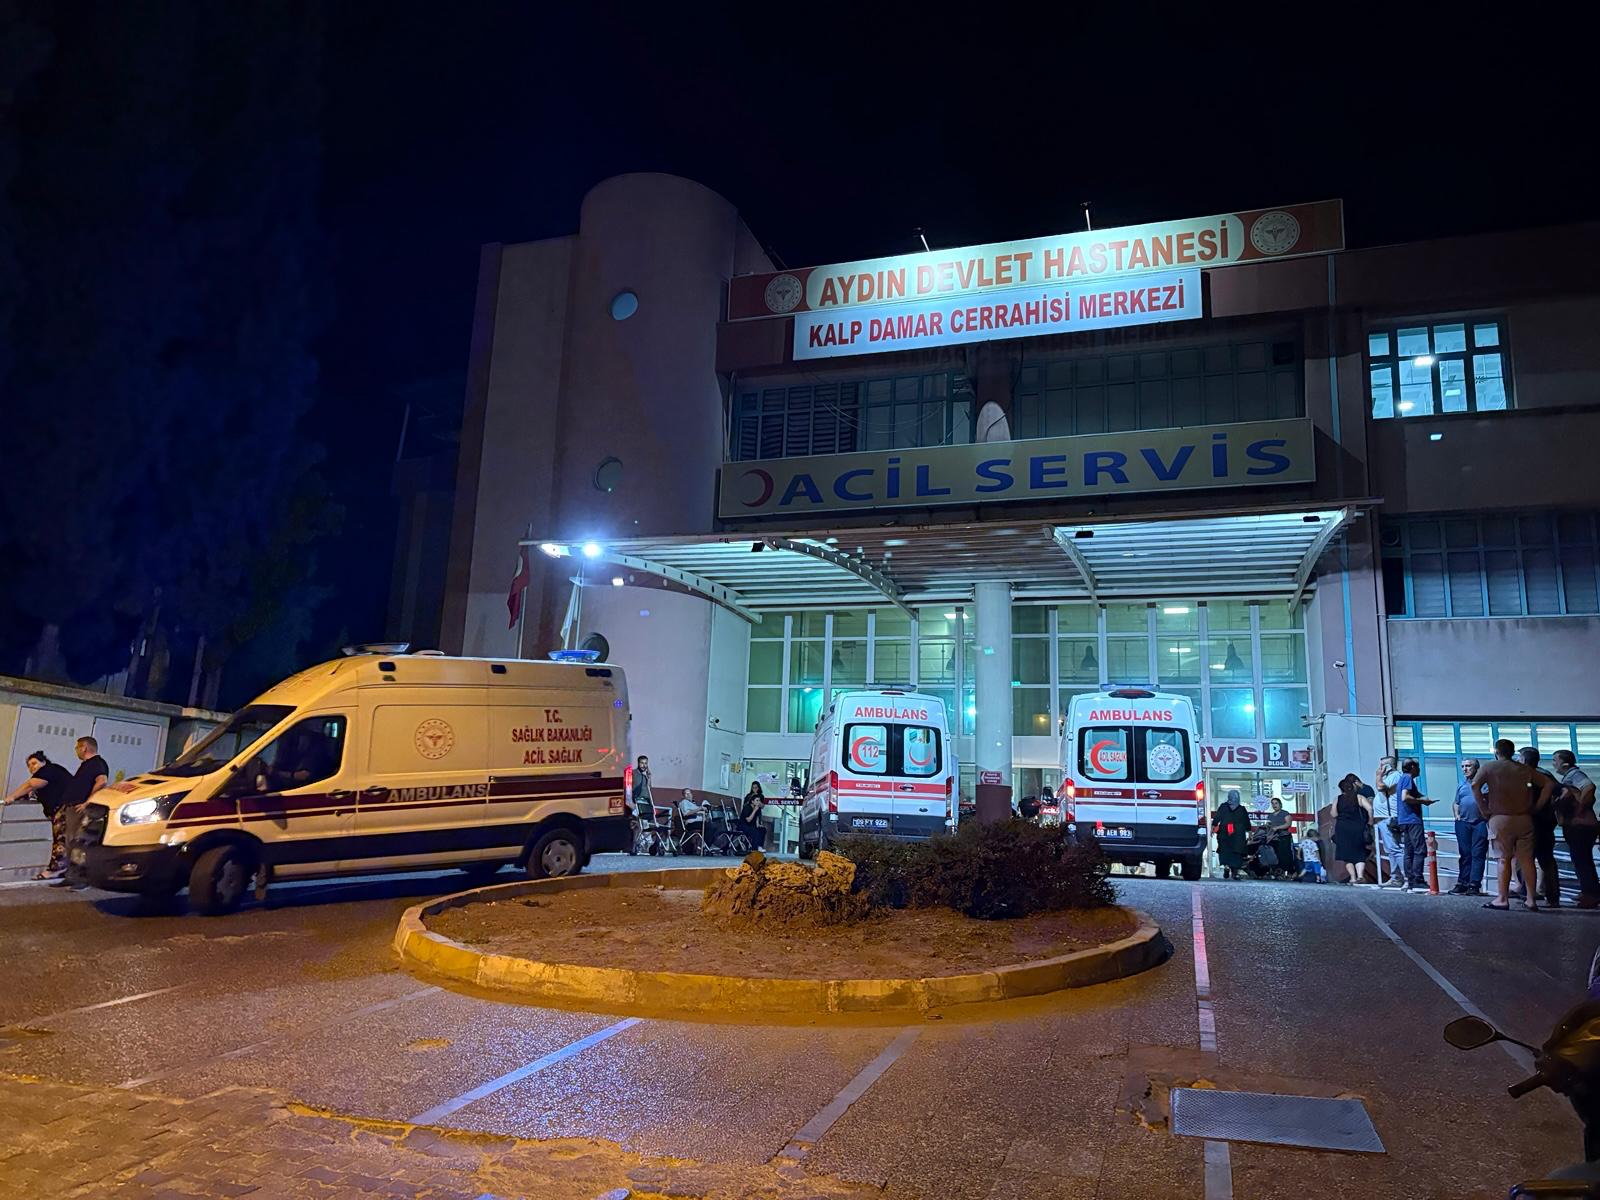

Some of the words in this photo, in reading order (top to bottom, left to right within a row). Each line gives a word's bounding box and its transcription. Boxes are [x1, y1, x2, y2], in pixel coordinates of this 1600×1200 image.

[819, 268, 906, 307] AYDIN
[917, 252, 1033, 295] DEVLET
[1044, 219, 1229, 279] HASTANESİ
[809, 320, 863, 348] KALP
[869, 312, 943, 342] DAMAR
[950, 291, 1071, 334] CERRAHİSİ
[1079, 278, 1185, 320] MERKEZİ
[778, 457, 951, 506] ACİL
[975, 432, 1291, 493] SERVİS
[544, 709, 563, 723] T.C.
[854, 706, 928, 721] AMBULANS
[1089, 710, 1173, 722] AMBULANS
[511, 725, 545, 742] SAĞLIK
[547, 725, 592, 742] BAKANLIĞI
[523, 747, 546, 765] ACİL
[548, 747, 582, 764] SAĞLIK
[862, 744, 879, 758] 112
[1269, 743, 1282, 761] B
[386, 784, 487, 803] AMBULANS
[611, 798, 622, 808] 112
[1248, 812, 1259, 820] CİL
